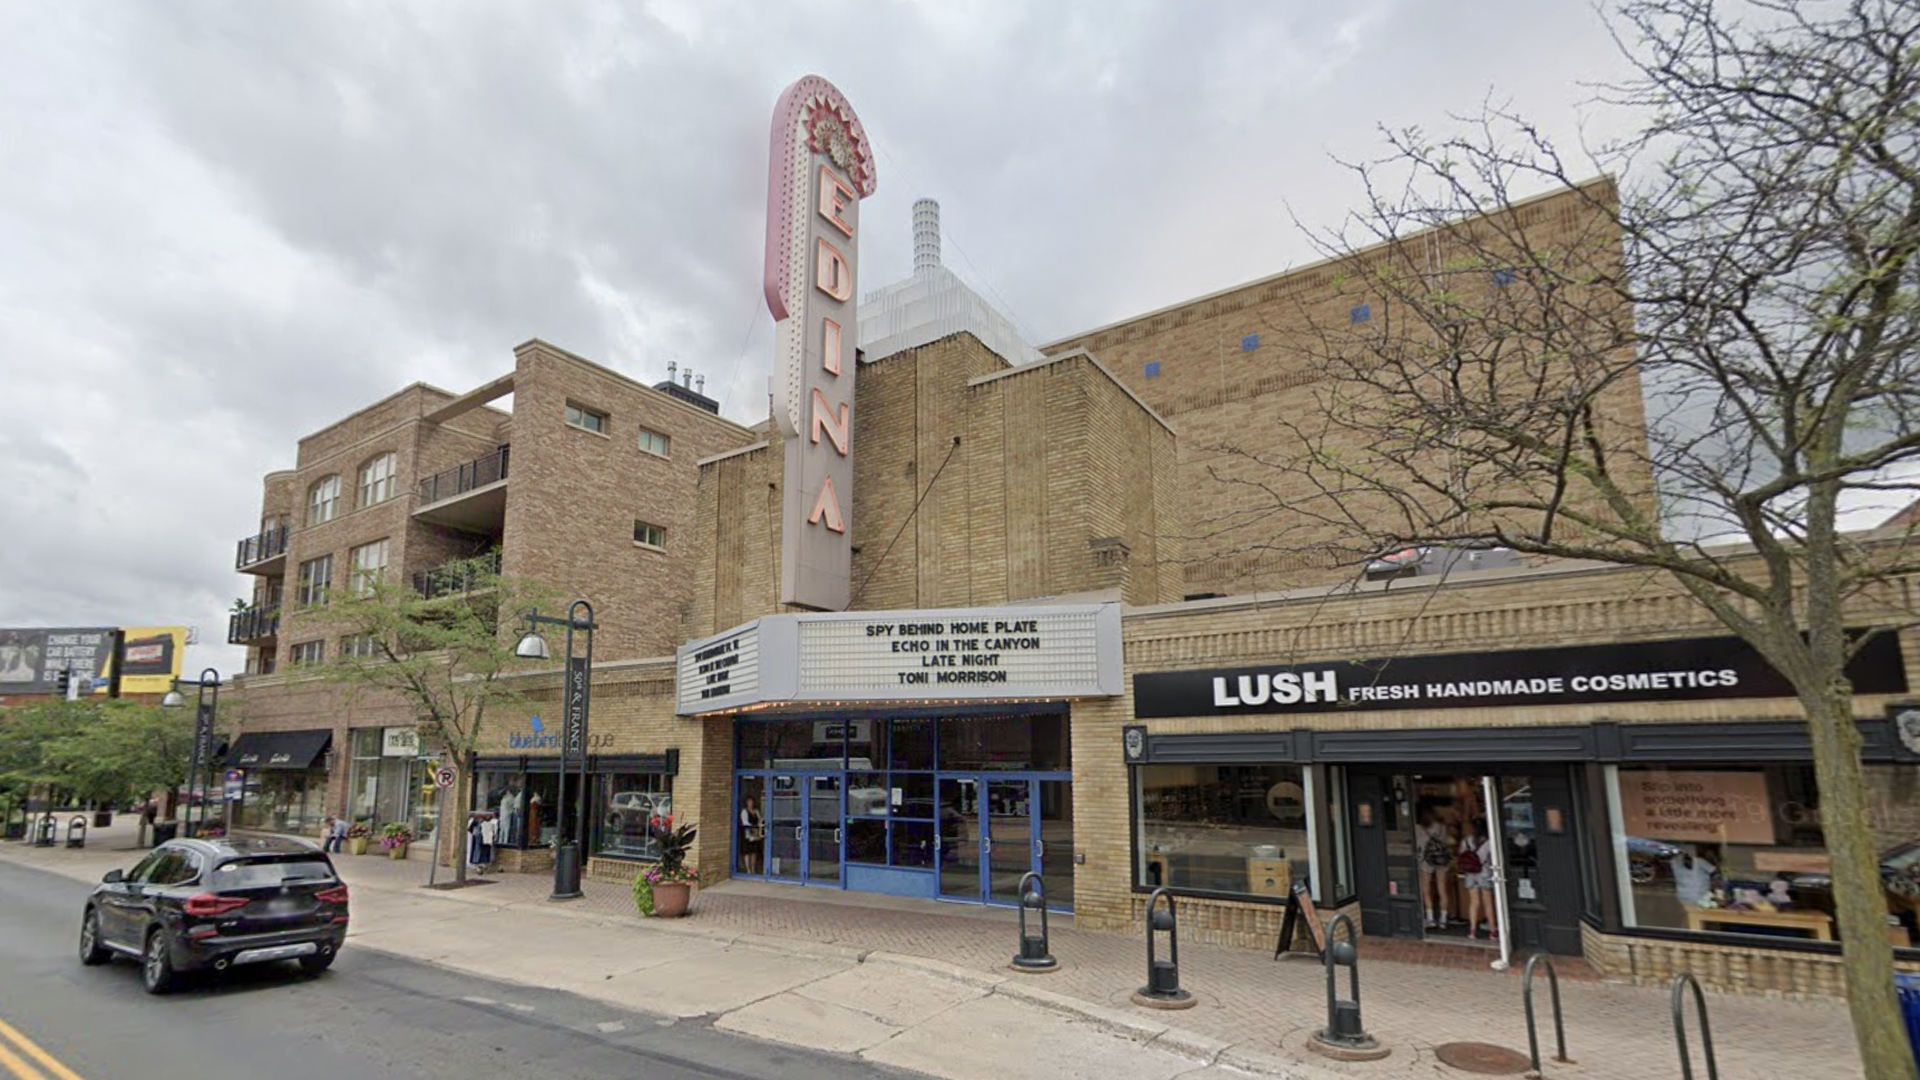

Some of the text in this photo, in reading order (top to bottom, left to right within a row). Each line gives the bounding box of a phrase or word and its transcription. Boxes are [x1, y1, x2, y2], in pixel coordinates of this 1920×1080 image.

[808, 165, 855, 535] EDINA
[866, 620, 1038, 637] SPY BEHIND HOME PLATE
[891, 637, 1040, 653] ECHO IN THE CANYON
[922, 653, 1000, 667] LATE NIGHT
[898, 670, 1007, 684] TONI MORRISON
[1212, 669, 1739, 707] LUSH FRESH HANDMADE COSMETICS
[571, 692, 583, 704] &
[570, 706, 582, 753] FRANCE
